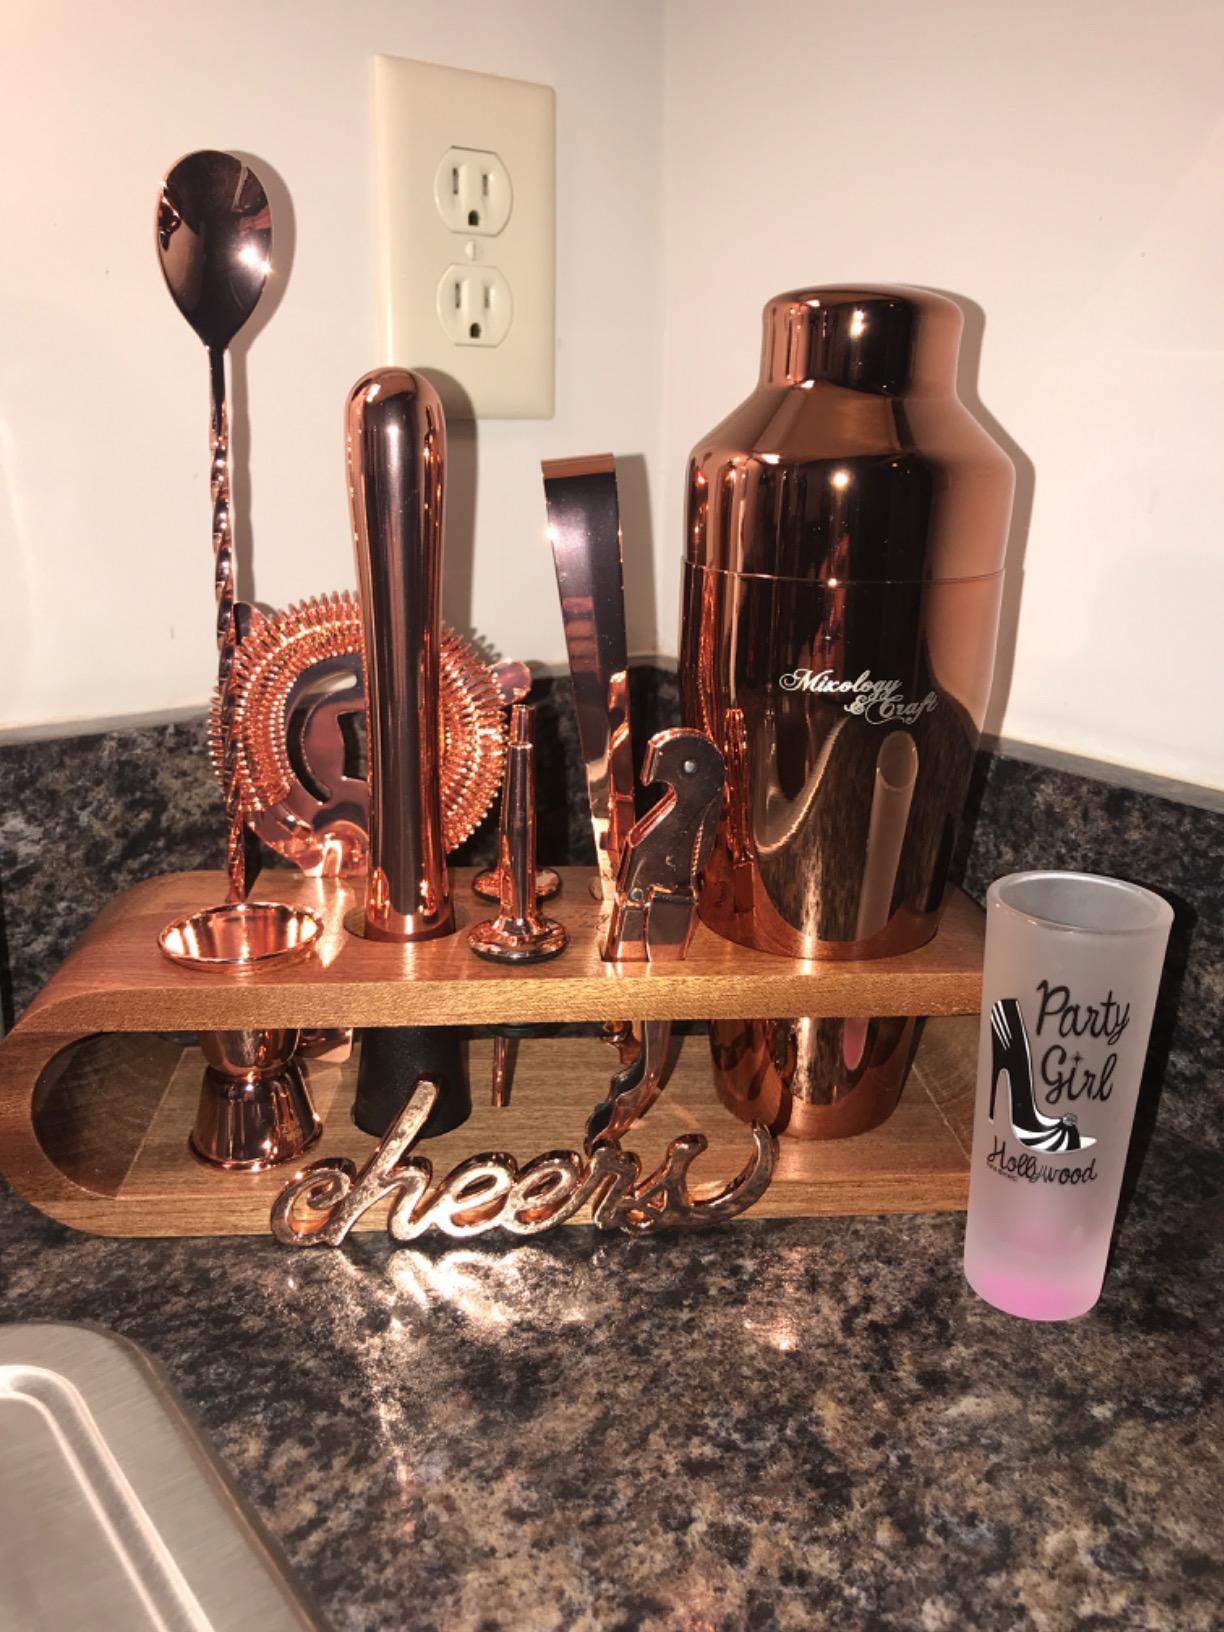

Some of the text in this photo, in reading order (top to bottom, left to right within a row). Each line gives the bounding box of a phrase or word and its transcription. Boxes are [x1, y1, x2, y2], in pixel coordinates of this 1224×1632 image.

[779, 668, 903, 702] Mixology
[843, 691, 939, 725] & Craft
[1036, 979, 1130, 1046] Party
[1041, 1044, 1118, 1105] Girl
[270, 1077, 779, 1247] cheers
[986, 1135, 1098, 1185] Hollywood
